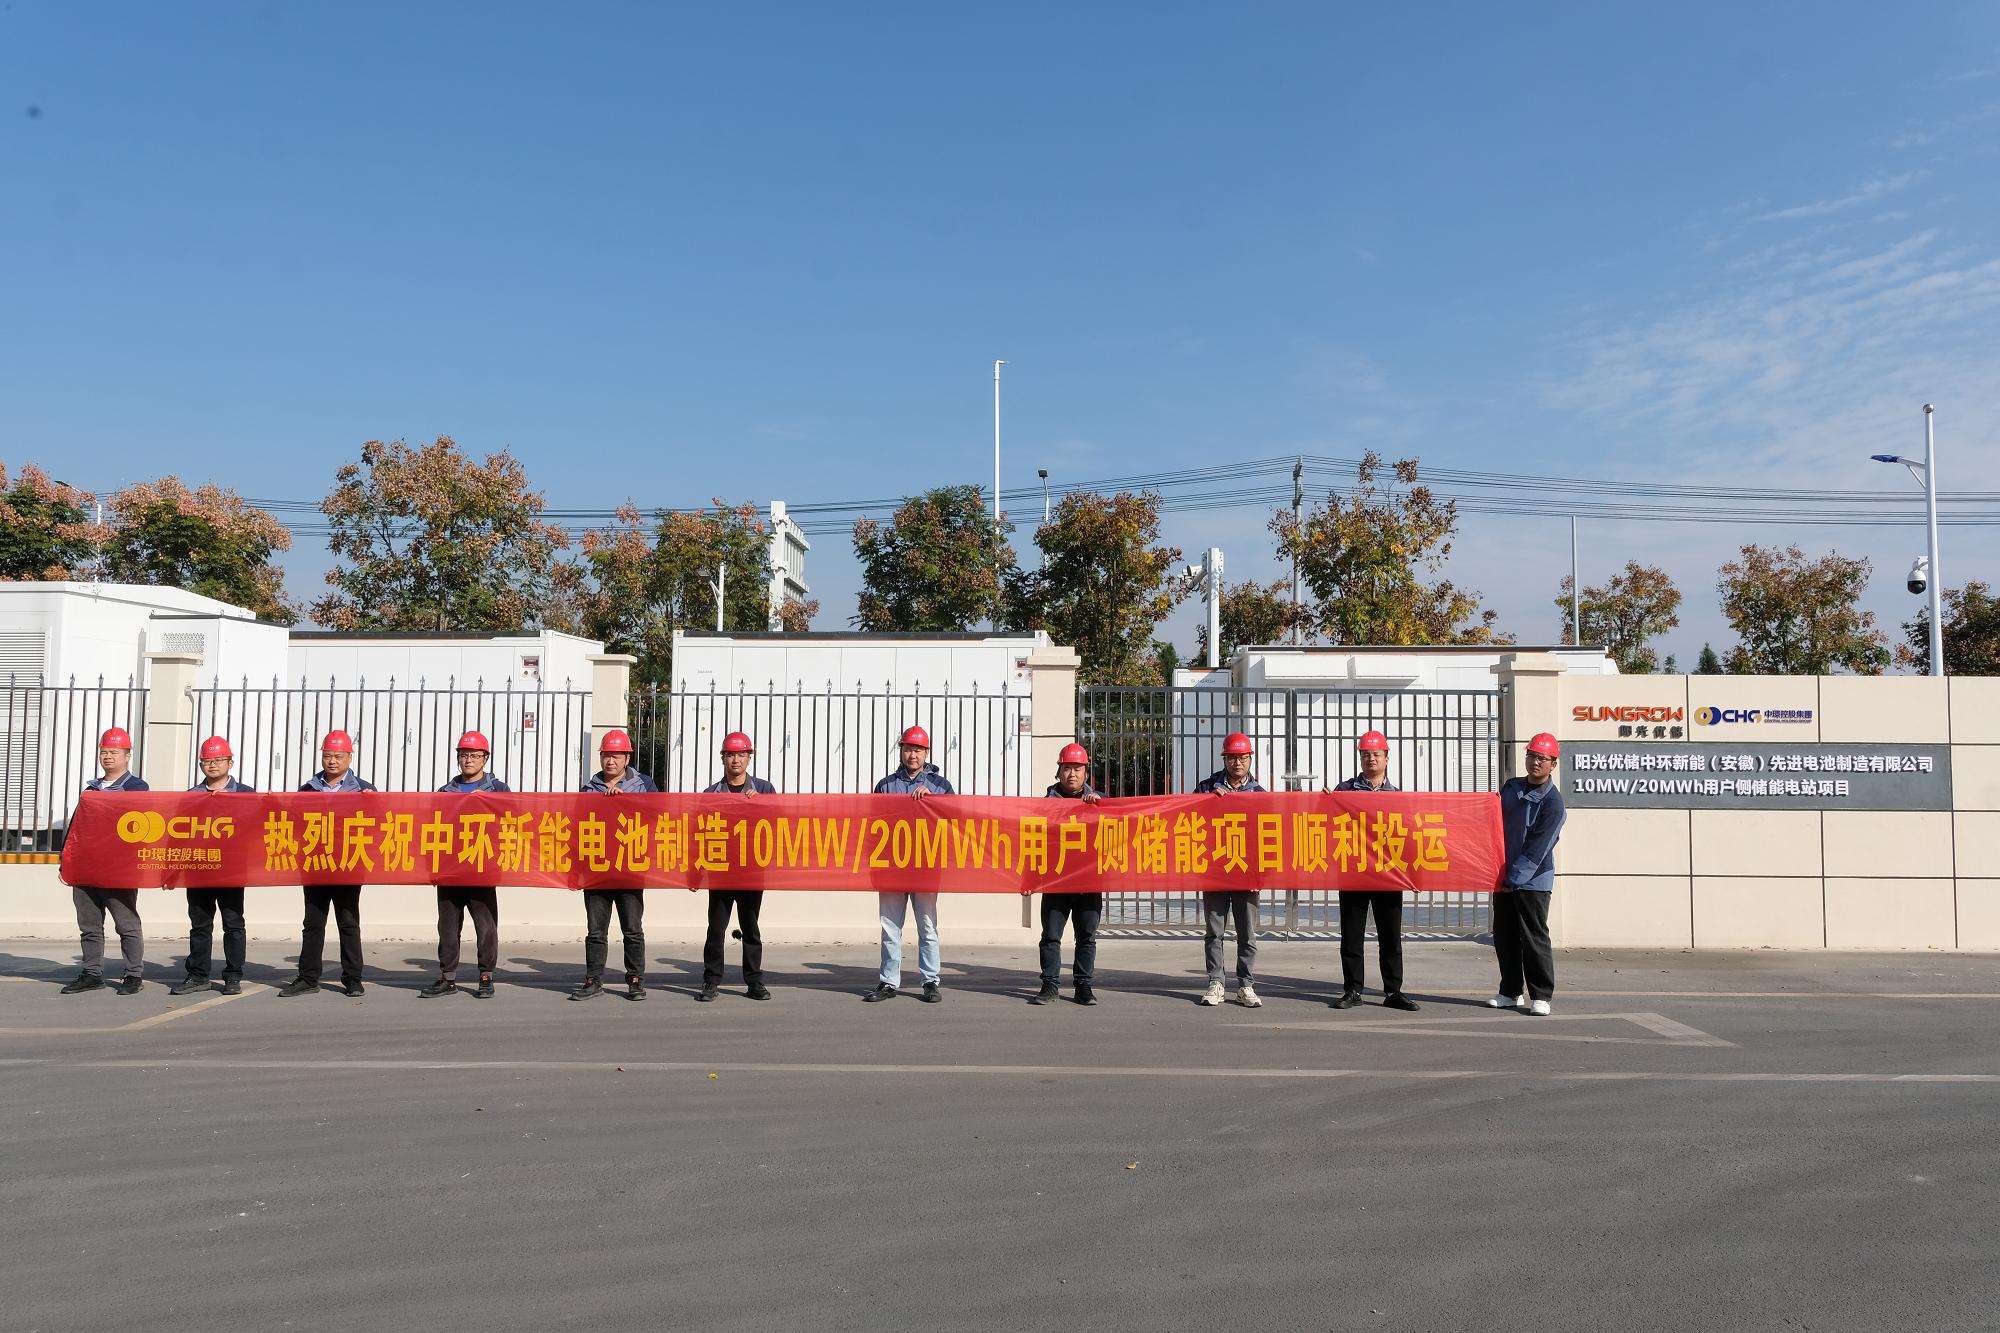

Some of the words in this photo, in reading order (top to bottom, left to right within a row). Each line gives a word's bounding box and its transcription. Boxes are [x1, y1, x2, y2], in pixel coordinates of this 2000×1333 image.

[1572, 706, 1684, 722] SUNGROW
[1721, 710, 1762, 723] CHG
[1574, 778, 1850, 797] 10MW/20MWh用户侧储能电站项目
[167, 816, 235, 839] CHG
[263, 809, 1450, 876] 热烈庆祝中环新能电池制造10MW/20MWh用户侧储能项目顺利投运
[137, 847, 221, 862] 中環控股集團
